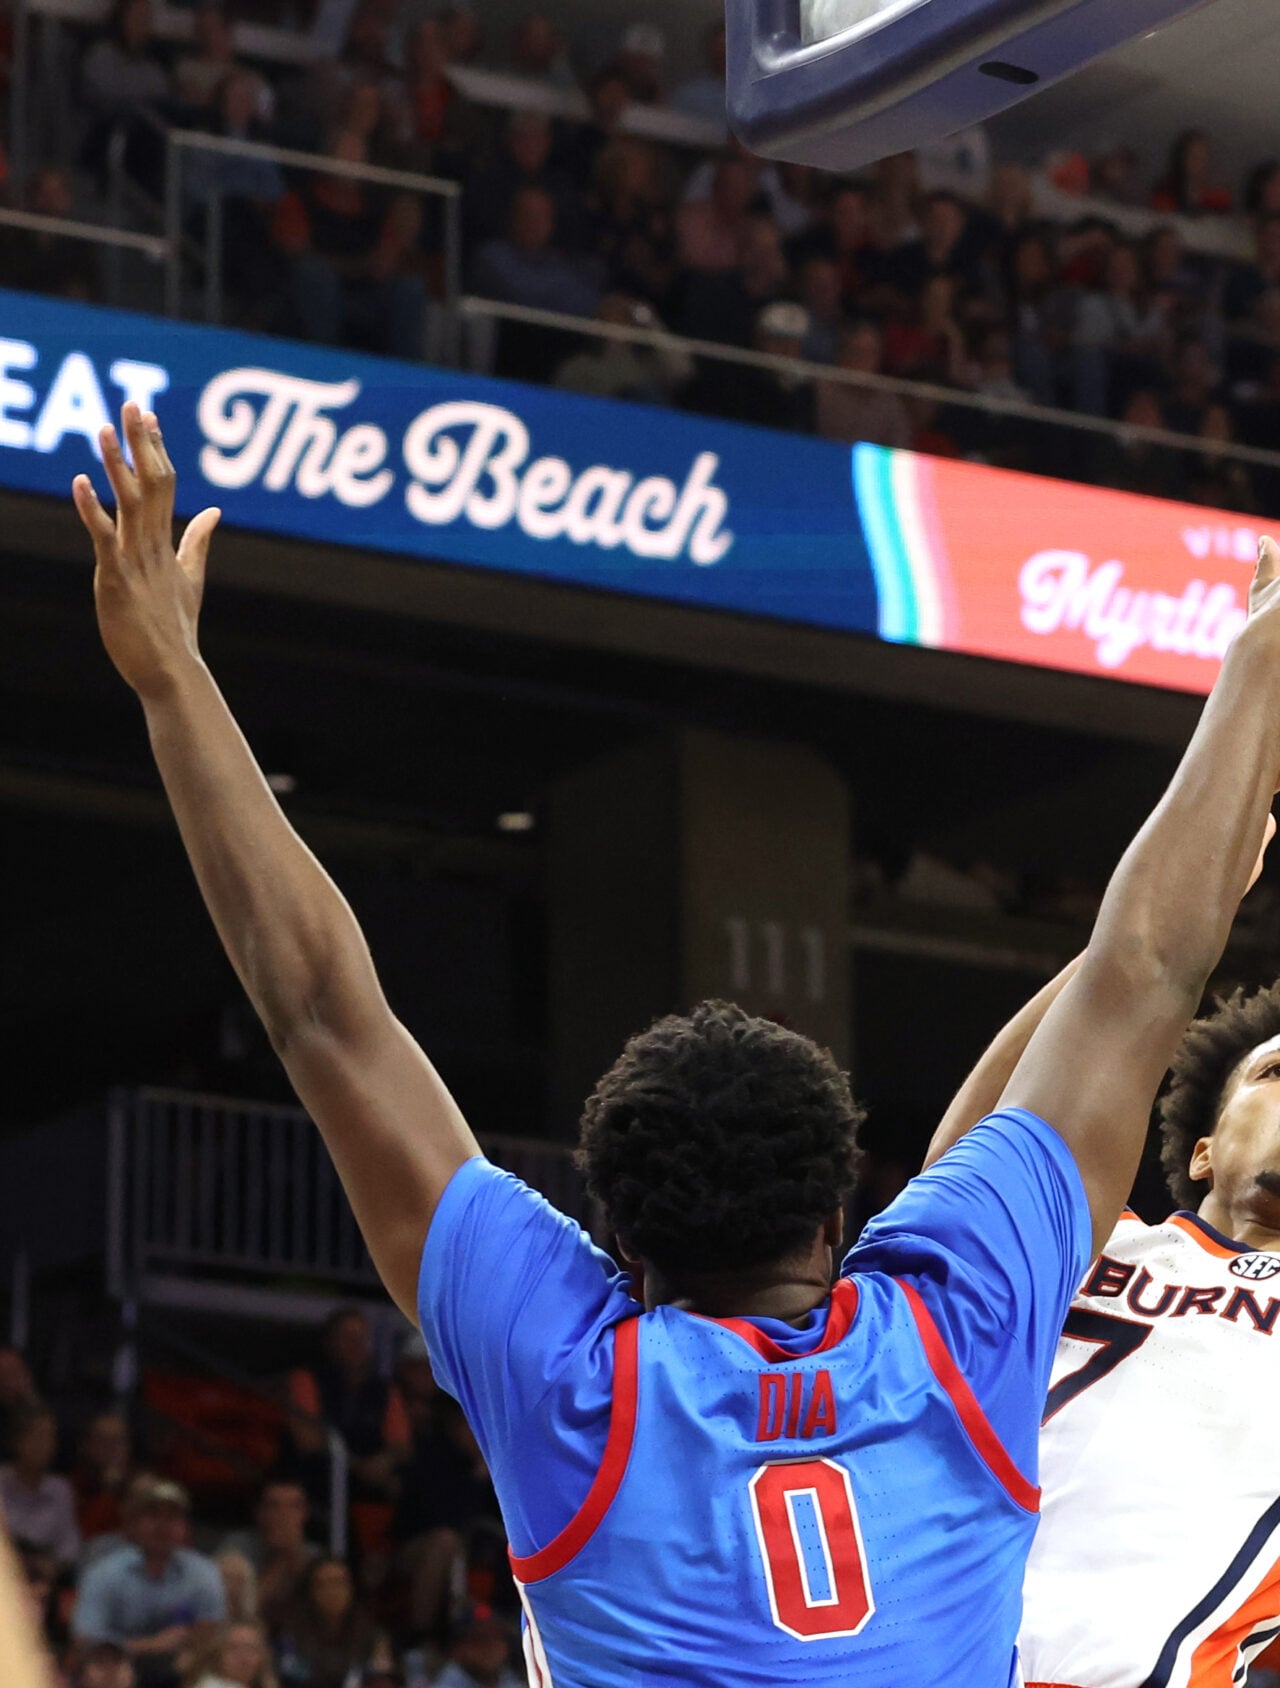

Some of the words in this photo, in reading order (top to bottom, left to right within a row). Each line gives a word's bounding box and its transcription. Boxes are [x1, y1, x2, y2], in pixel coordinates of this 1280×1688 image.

[198, 367, 396, 507] The
[403, 400, 735, 565] Beach
[728, 917, 826, 1001] 111
[756, 1370, 837, 1442] DIA
[748, 1455, 876, 1642] 0
